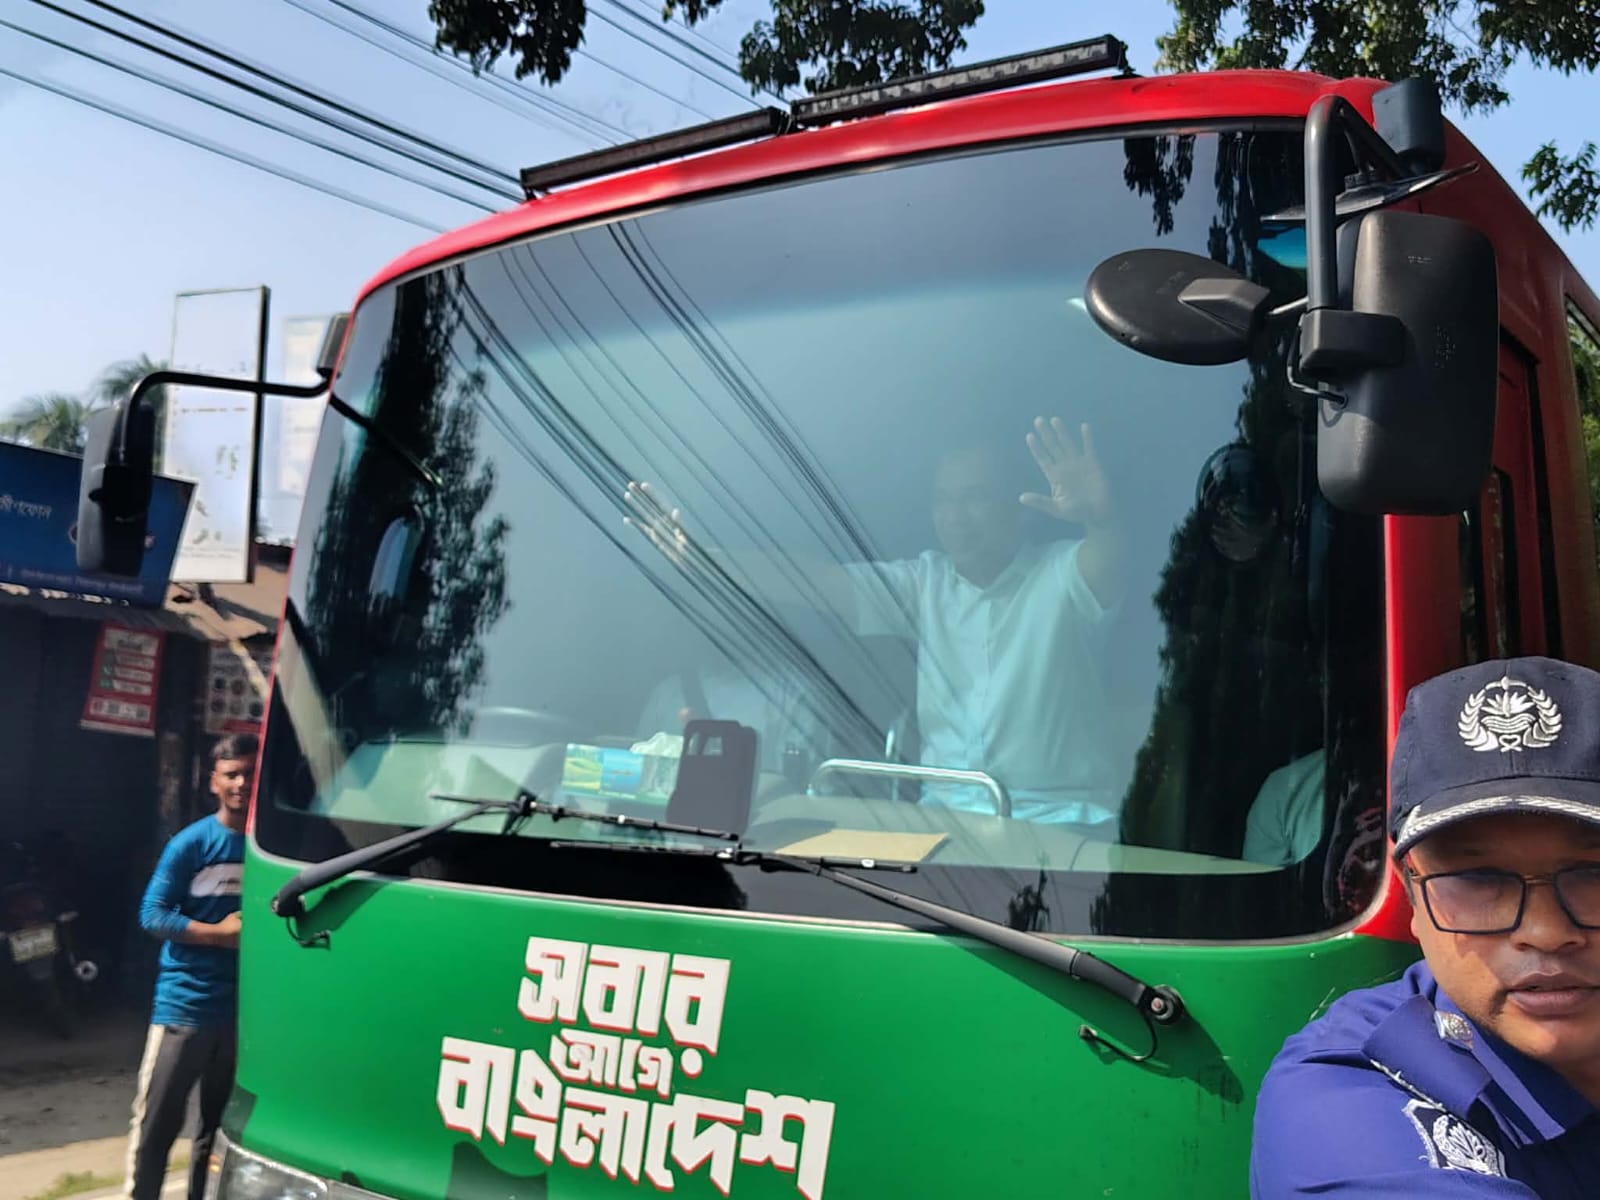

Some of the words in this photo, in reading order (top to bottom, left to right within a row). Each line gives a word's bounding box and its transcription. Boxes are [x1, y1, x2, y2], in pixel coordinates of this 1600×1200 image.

[517, 936, 731, 1077] সবার
[549, 1027, 674, 1100] আগে
[436, 1036, 836, 1200] বাংলাদেশ
